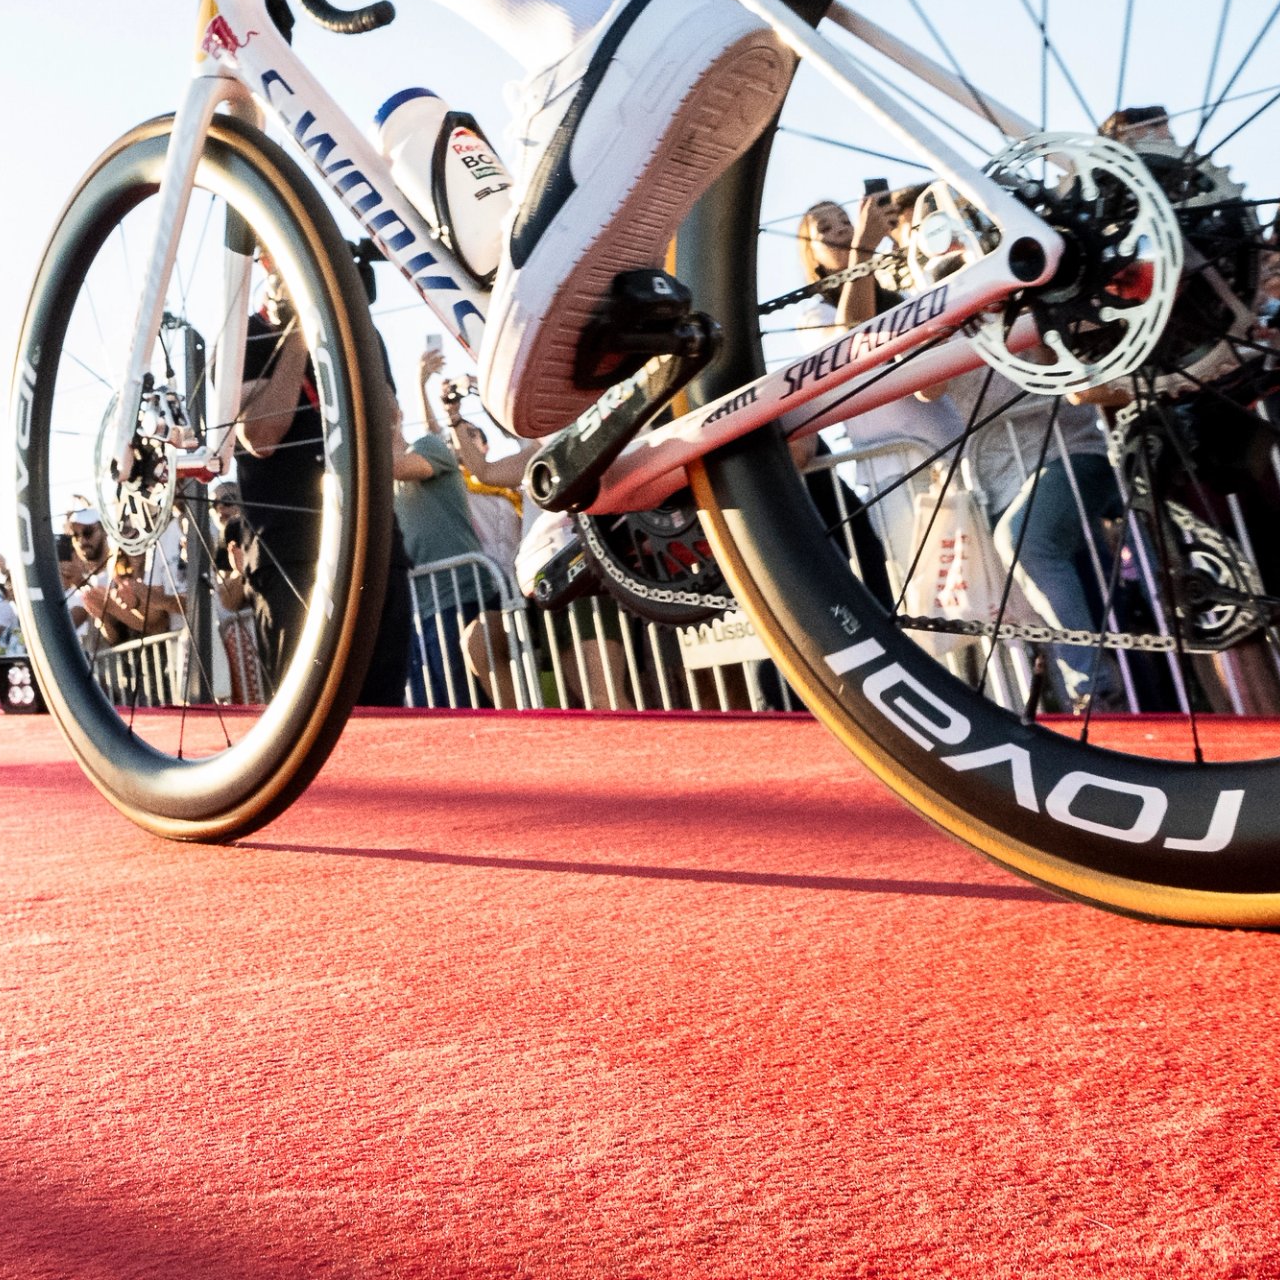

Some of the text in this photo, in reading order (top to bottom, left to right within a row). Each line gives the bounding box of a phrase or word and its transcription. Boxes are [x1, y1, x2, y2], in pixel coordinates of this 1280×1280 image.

[779, 284, 949, 401] SPECIALIZED
[712, 620, 756, 643] LISBO
[824, 637, 1245, 852] roval
